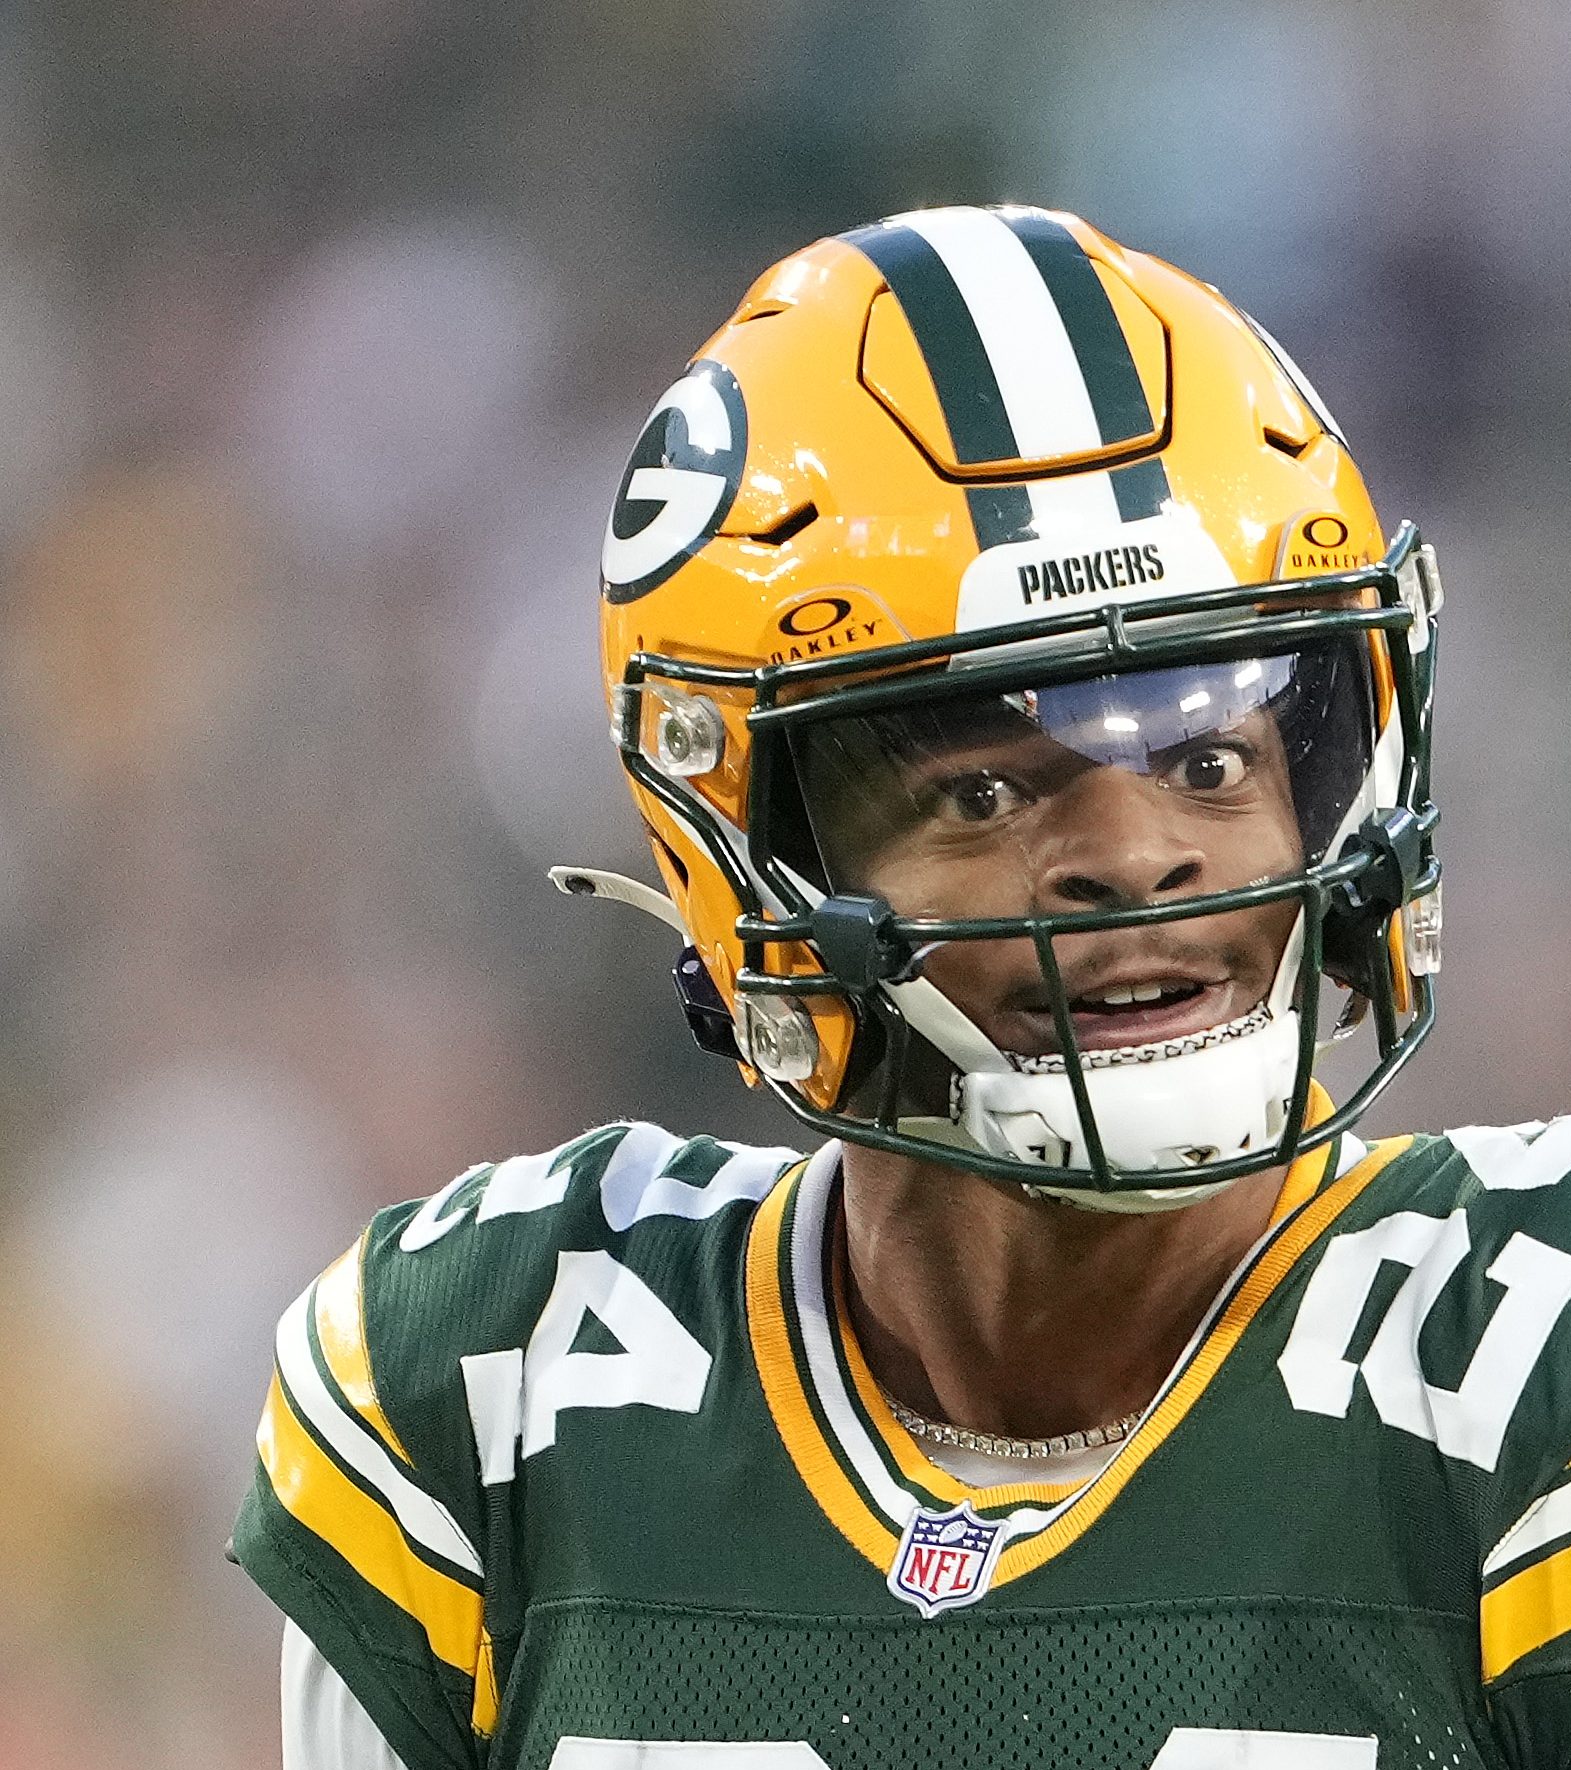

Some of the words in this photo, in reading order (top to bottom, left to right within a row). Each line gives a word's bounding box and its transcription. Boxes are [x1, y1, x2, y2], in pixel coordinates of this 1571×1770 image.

[601, 374, 733, 586] G
[1017, 543, 1165, 606] PACKERS
[1292, 553, 1358, 569] OAKLEY
[770, 620, 877, 665] OAKLEY
[904, 1546, 971, 1597] NFL
